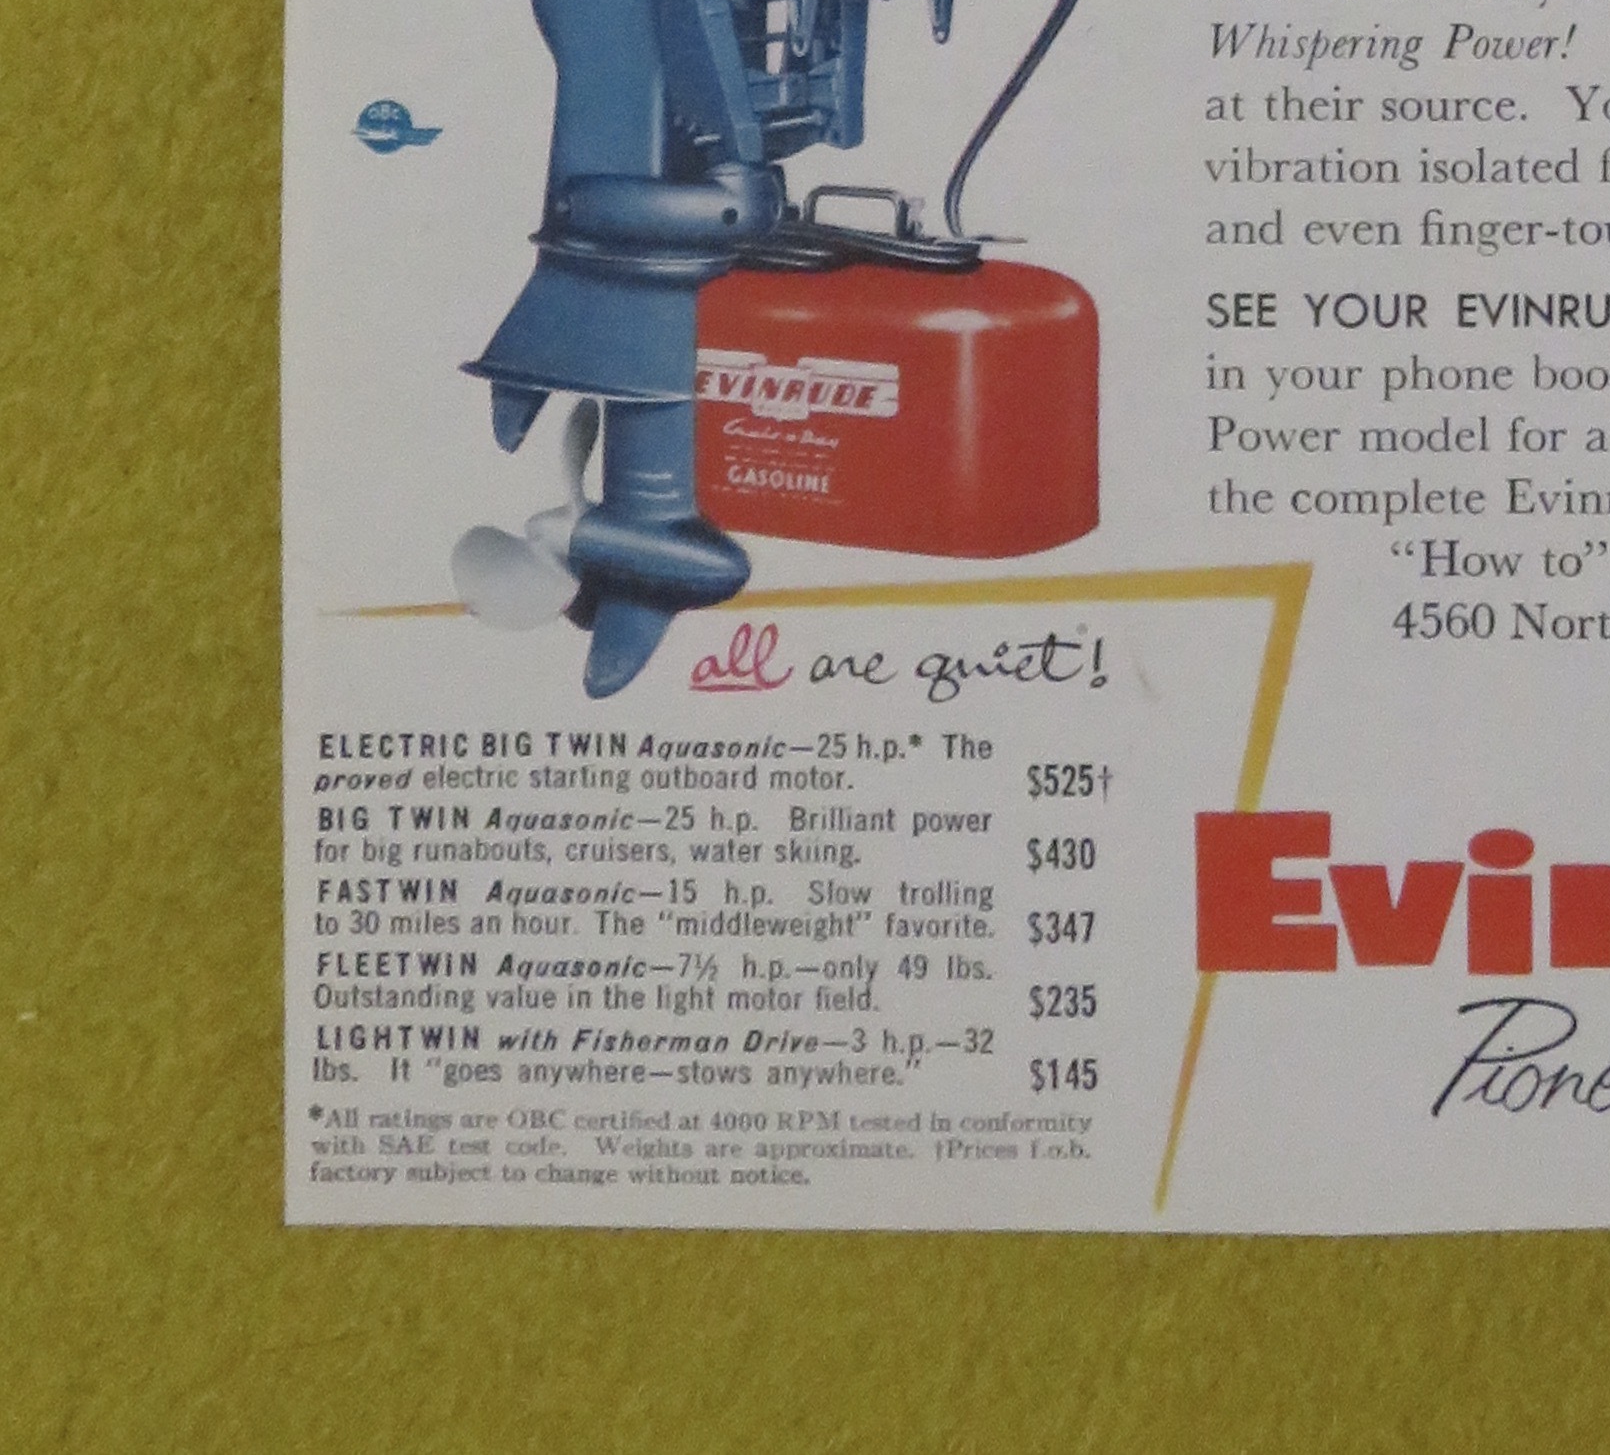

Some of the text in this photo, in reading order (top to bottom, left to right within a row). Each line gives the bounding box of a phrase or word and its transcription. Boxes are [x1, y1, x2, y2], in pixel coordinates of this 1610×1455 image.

[1211, 23, 1423, 71] Whispering
[1443, 23, 1577, 59] Power!
[1206, 209, 1283, 245] and
[1304, 221, 1401, 245] even
[697, 370, 877, 409] EVINRUDE
[1207, 353, 1245, 389] in
[1266, 367, 1362, 401] your
[1383, 354, 1513, 401] phone
[1208, 415, 1341, 452] Power
[1360, 416, 1489, 452] model
[1509, 416, 1567, 452] for
[727, 465, 829, 493] GASOLINE
[1393, 602, 1496, 639] 4560
[691, 622, 1108, 703] all are quiet!
[319, 732, 469, 760] ELECTRIC
[481, 731, 532, 758] BIG
[545, 731, 627, 758] TWIN
[941, 733, 993, 760] The
[314, 764, 853, 794] proved electric starting outboard motor.
[315, 837, 861, 869] for big runabouts, cruisers, water skiing.
[1027, 837, 1096, 875] $430
[1027, 910, 1096, 947] $347
[314, 983, 878, 1016] Outstanding value in the light motor field.
[1029, 983, 1098, 1021] $235
[1030, 1057, 1099, 1095] $145
